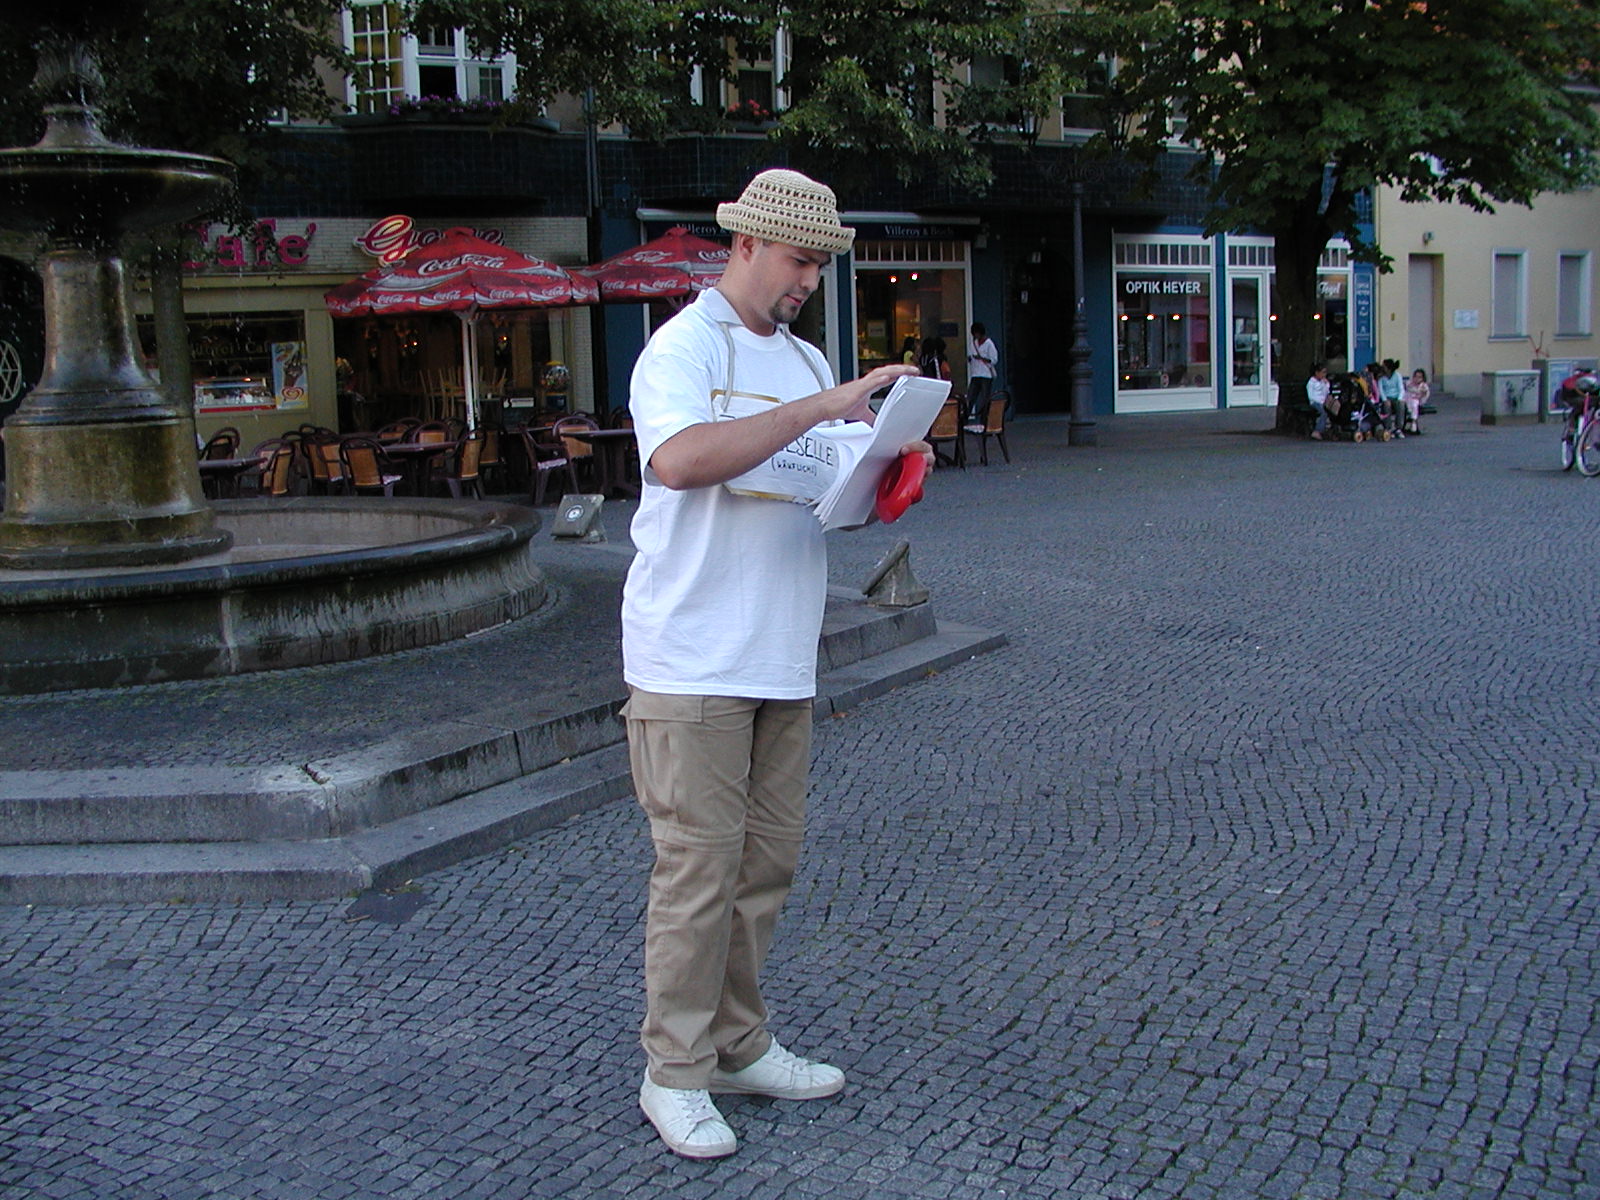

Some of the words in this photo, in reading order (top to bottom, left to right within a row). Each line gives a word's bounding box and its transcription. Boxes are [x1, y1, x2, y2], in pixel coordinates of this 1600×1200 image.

[884, 224, 920, 236] Villeroy
[1126, 281, 1160, 294] OPTIK
[1163, 281, 1201, 294] HEYER
